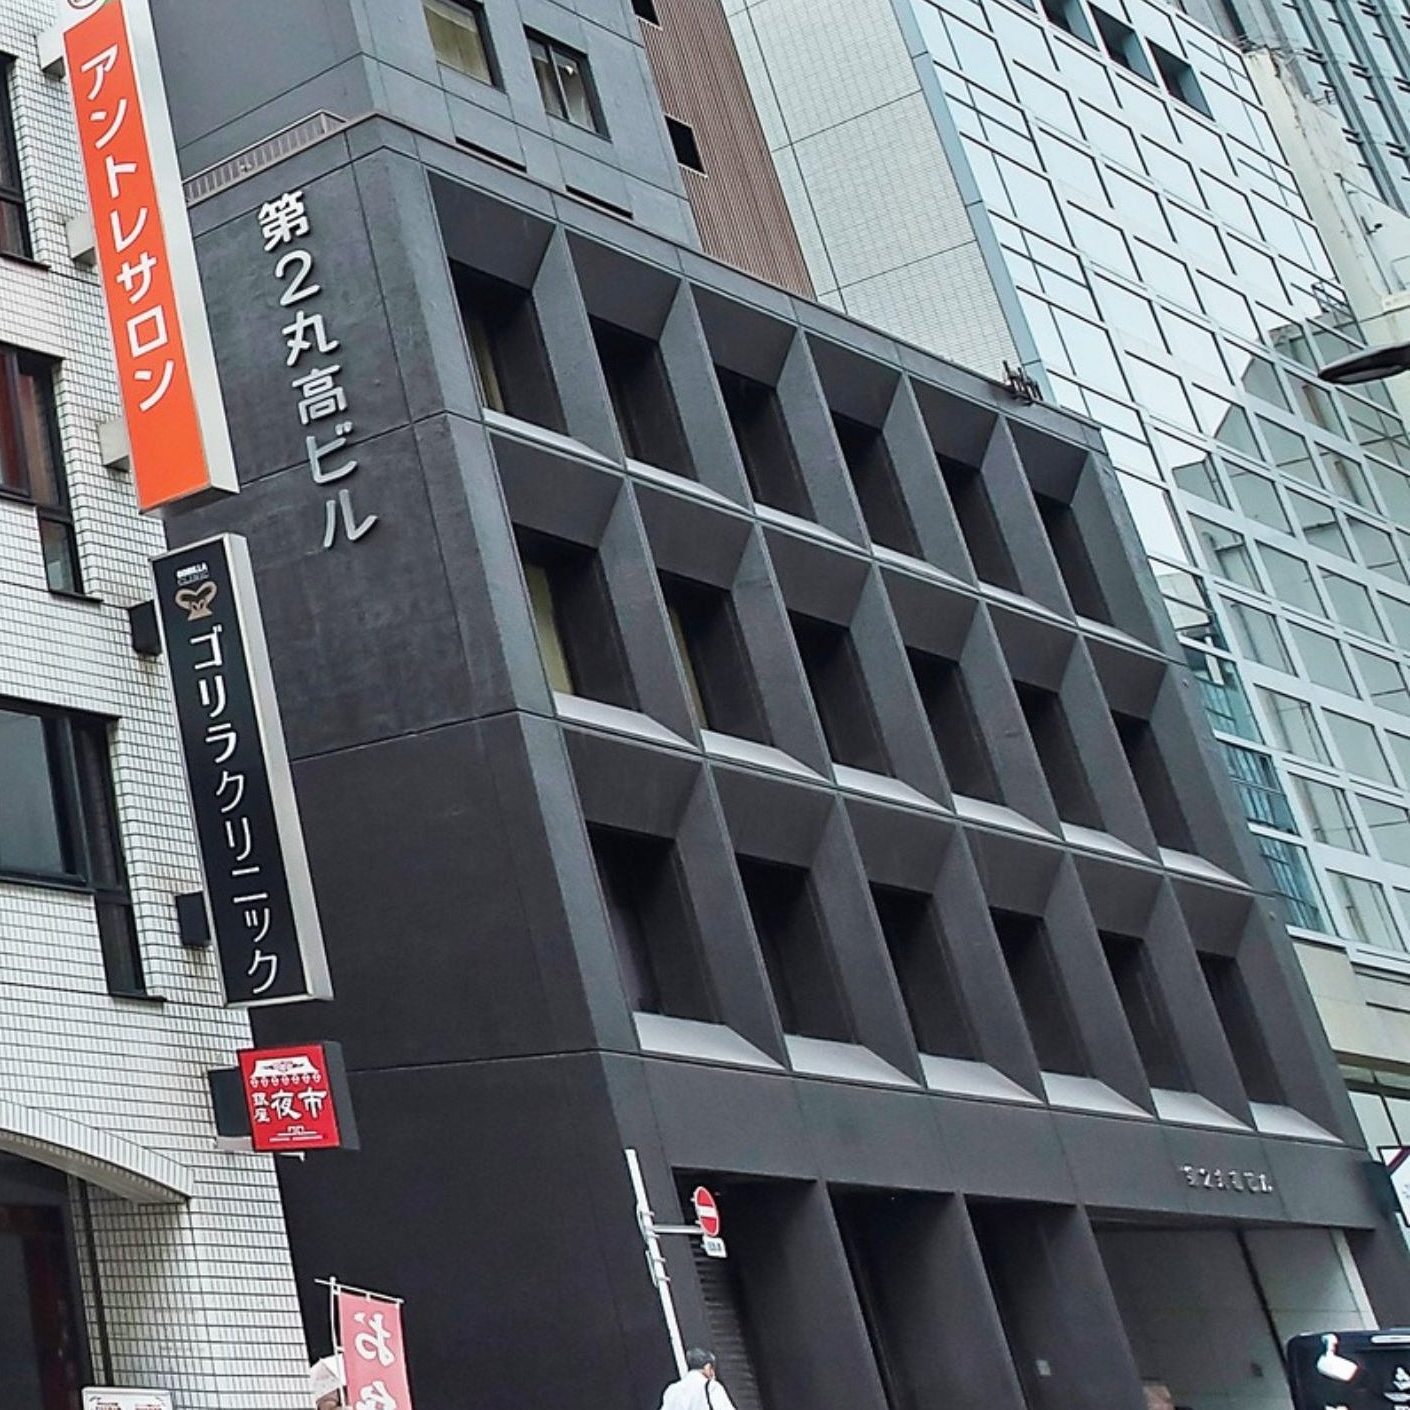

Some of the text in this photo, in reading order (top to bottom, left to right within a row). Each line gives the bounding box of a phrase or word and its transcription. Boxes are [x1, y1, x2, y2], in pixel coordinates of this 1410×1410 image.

[80, 43, 175, 413] アントレサロン
[257, 190, 379, 550] 第2丸高ビル
[189, 623, 279, 996] ゴリラクリニック
